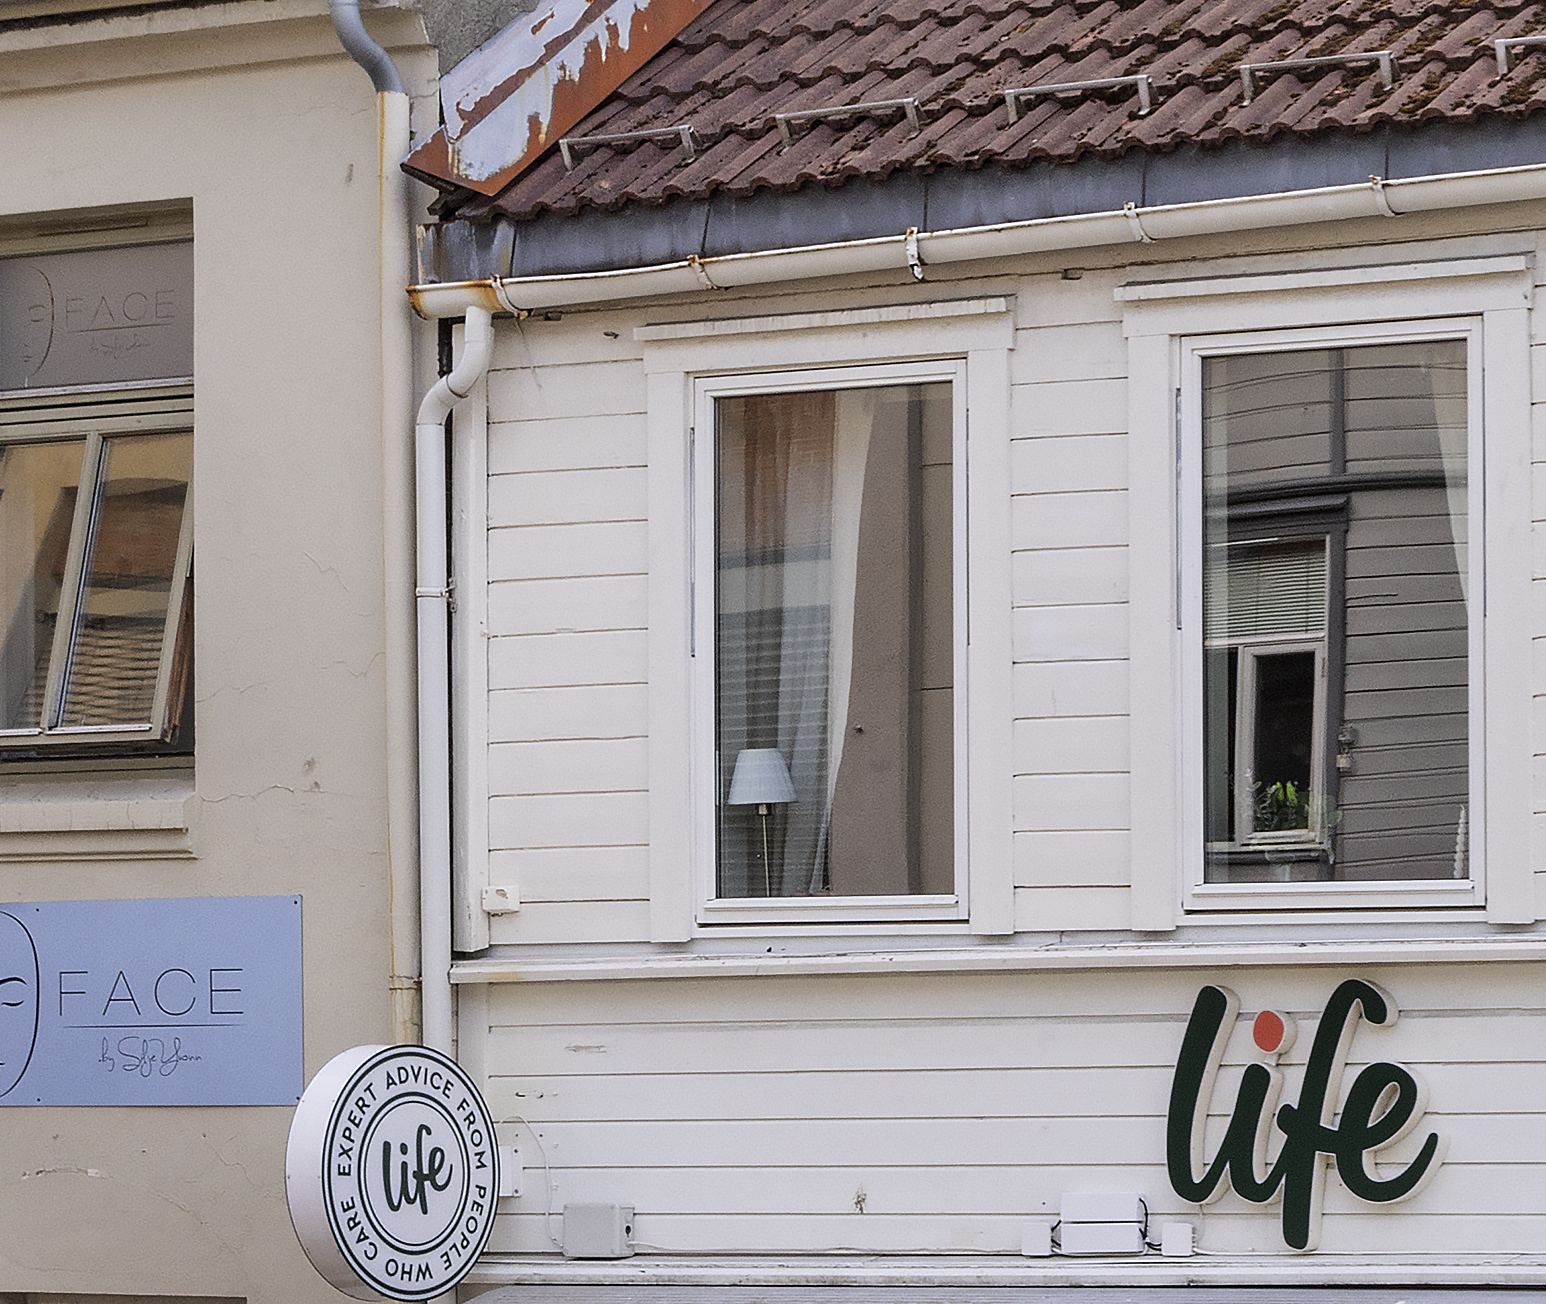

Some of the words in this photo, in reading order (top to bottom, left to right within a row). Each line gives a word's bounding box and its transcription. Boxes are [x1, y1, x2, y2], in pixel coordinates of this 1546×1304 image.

[66, 290, 175, 327] FACE
[59, 968, 245, 1016] FACE
[385, 1065, 454, 1099] ADVICE
[1166, 978, 1440, 1251] life
[337, 1082, 378, 1177] EXPERT
[456, 1098, 488, 1170] FROM
[382, 1123, 453, 1215] life
[340, 1196, 378, 1261] CARE
[440, 1184, 487, 1271] PEOPLE
[385, 1258, 433, 1282] WHO
